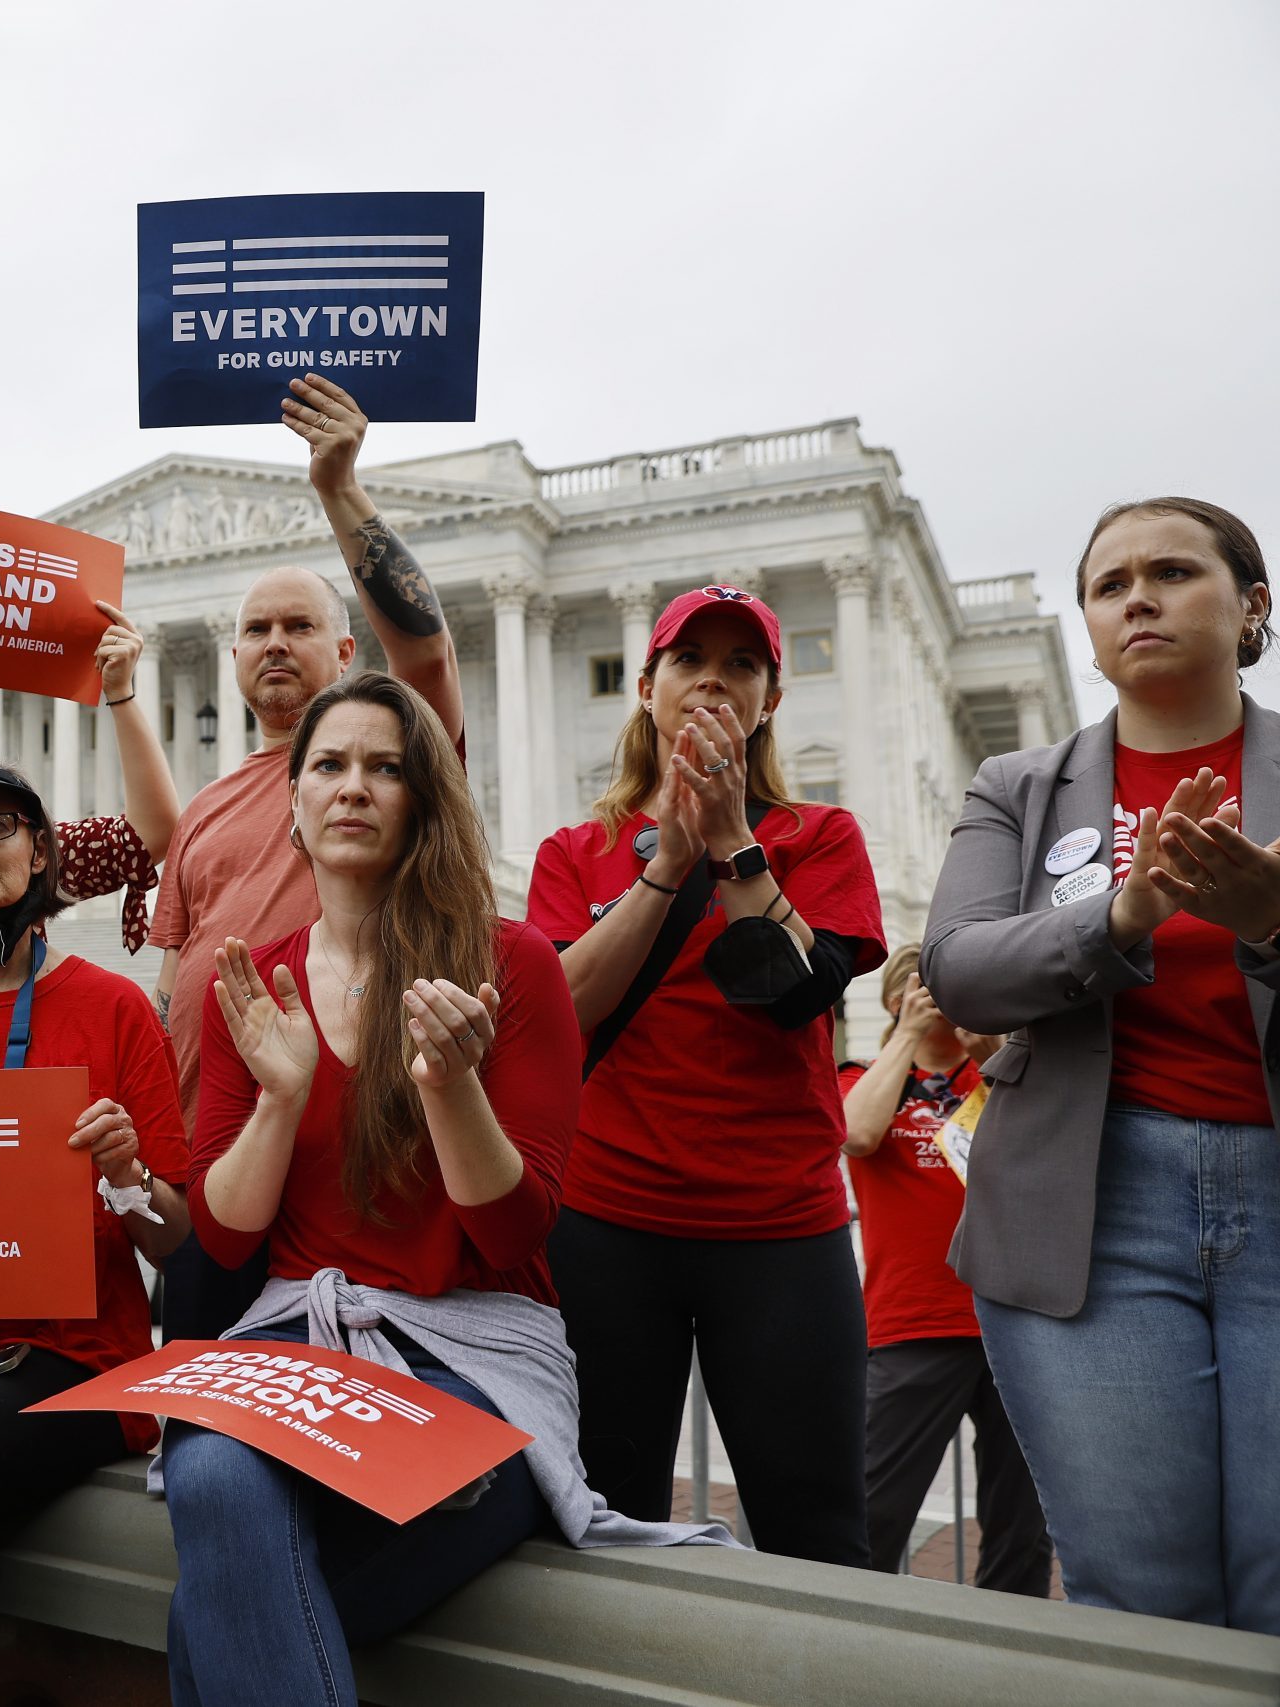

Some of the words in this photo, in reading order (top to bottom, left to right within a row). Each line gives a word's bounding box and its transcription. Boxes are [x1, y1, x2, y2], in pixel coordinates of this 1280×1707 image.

[172, 305, 448, 342] EVERYTOWN
[218, 352, 261, 370] FOR
[267, 350, 314, 367] GUN
[320, 349, 402, 367] SAFETY
[7, 636, 64, 655] AMERICA
[1048, 843, 1094, 862] EVERYTOWN
[1054, 874, 1083, 895] MOMS
[1055, 872, 1098, 900] DEMAND
[1058, 880, 1095, 905] ACTION
[917, 1157, 945, 1169] SEA
[189, 1351, 344, 1384] MOMS
[138, 1373, 335, 1424] ACTION
[165, 1363, 383, 1422] DEMAND
[123, 1385, 159, 1394] FOR
[162, 1385, 195, 1396] GUN
[196, 1389, 256, 1409] SENSE
[255, 1403, 279, 1418] IN
[276, 1415, 363, 1462] AMERICA
